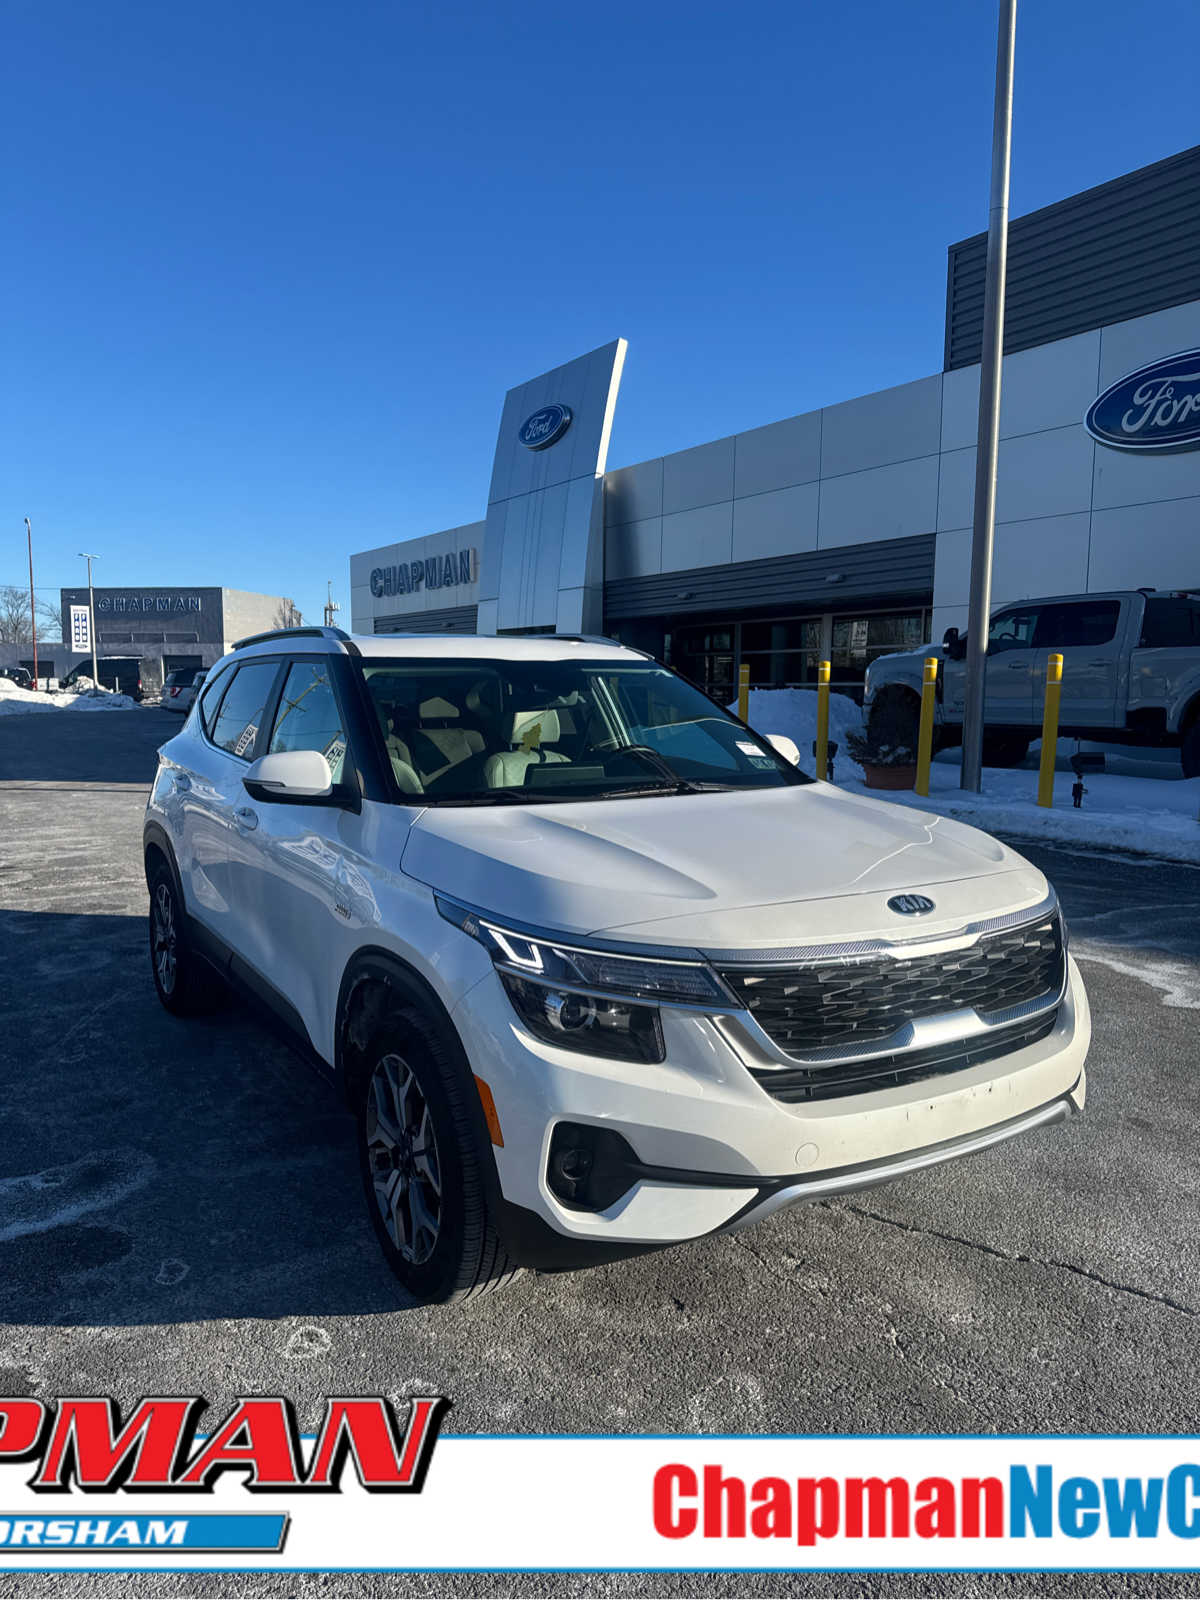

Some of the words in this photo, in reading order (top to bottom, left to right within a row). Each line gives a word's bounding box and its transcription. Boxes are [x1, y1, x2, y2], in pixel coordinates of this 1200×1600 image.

[525, 414, 553, 440] Ford
[370, 548, 477, 598] CHAPMAN
[98, 597, 201, 612] CHAPMAN
[894, 895, 932, 912] KIA
